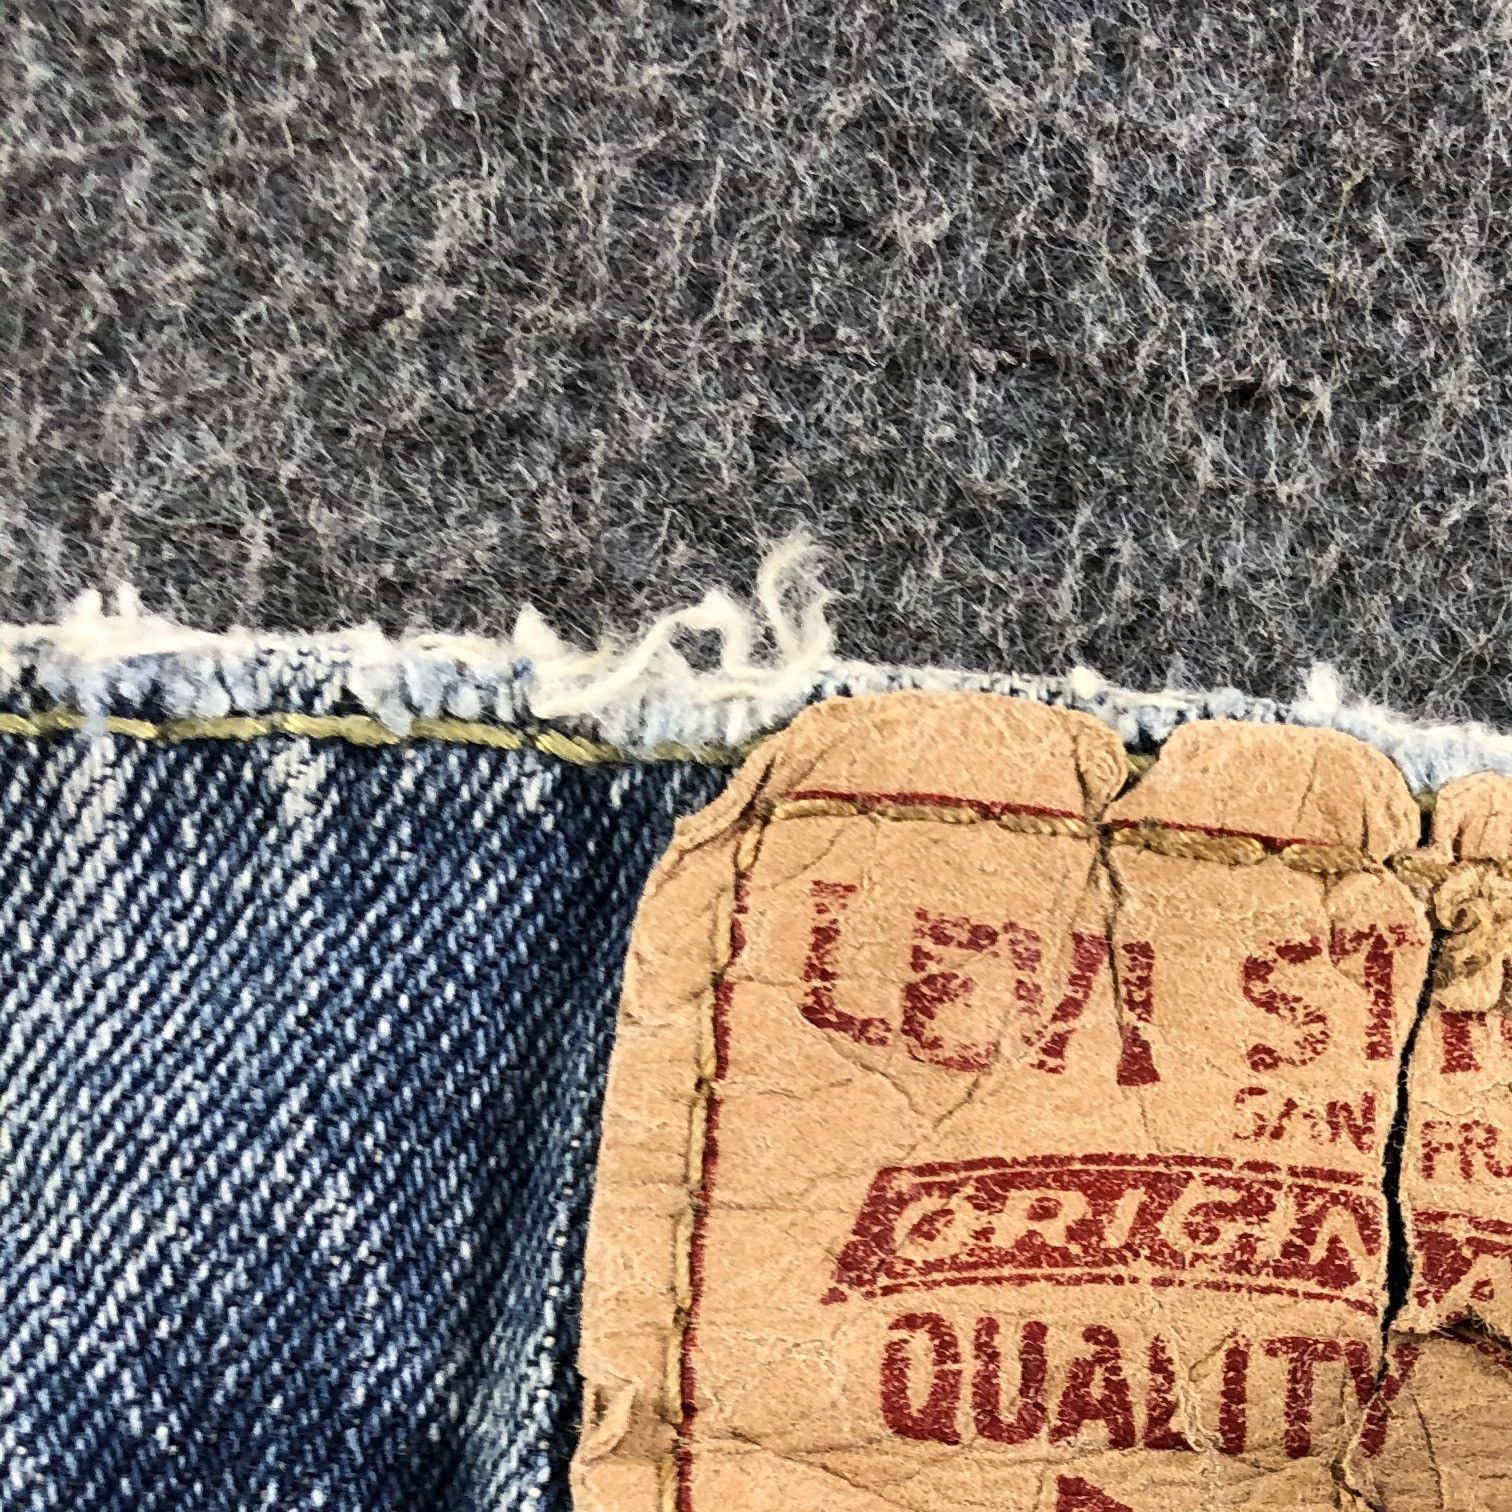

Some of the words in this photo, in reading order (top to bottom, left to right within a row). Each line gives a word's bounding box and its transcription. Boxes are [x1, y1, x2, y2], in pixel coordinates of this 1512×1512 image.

[799, 879, 1162, 1087] LEVI
[1232, 1086, 1377, 1153] SAN
[880, 1312, 1421, 1459] QUALITY
